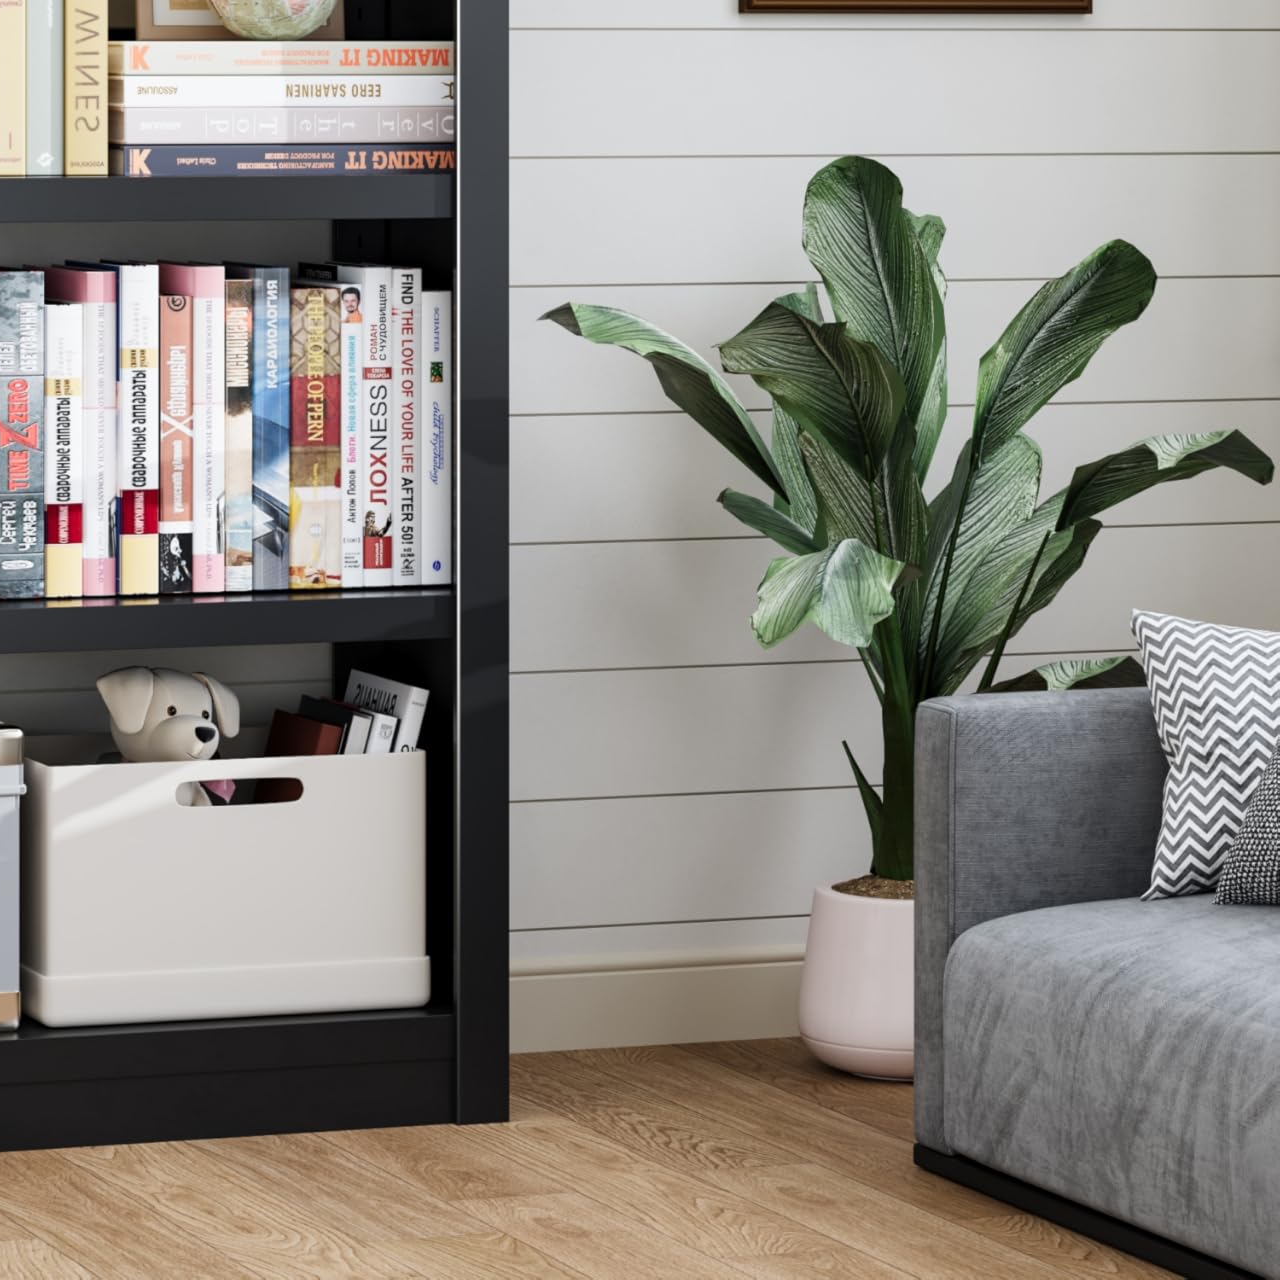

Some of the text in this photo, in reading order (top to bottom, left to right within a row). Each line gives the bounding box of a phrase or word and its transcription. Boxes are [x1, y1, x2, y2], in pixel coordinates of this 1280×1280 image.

[285, 84, 381, 97] EERO SAARINEN
[339, 48, 449, 66] MAKING IT
[344, 150, 456, 169] MAKING IT
[227, 306, 248, 387] МИССИОНЕРЫ
[267, 279, 279, 389] КАРДИОЛОГИЯ
[370, 324, 378, 361] РОМАН
[379, 284, 387, 352] ЧУДОВИЩЕМ
[131, 370, 147, 488] сварочные аппараты
[307, 402, 323, 441] PERN
[401, 273, 414, 522] FIND THE LOVE OF YOUR LIFE AFTER
[8, 378, 28, 491] TIME ZERO
[56, 397, 70, 502] сварочные аппараты
[369, 385, 388, 505] ЛОХNESS
[21, 501, 37, 551] Чекмаев
[347, 470, 356, 523] Антон Попов
